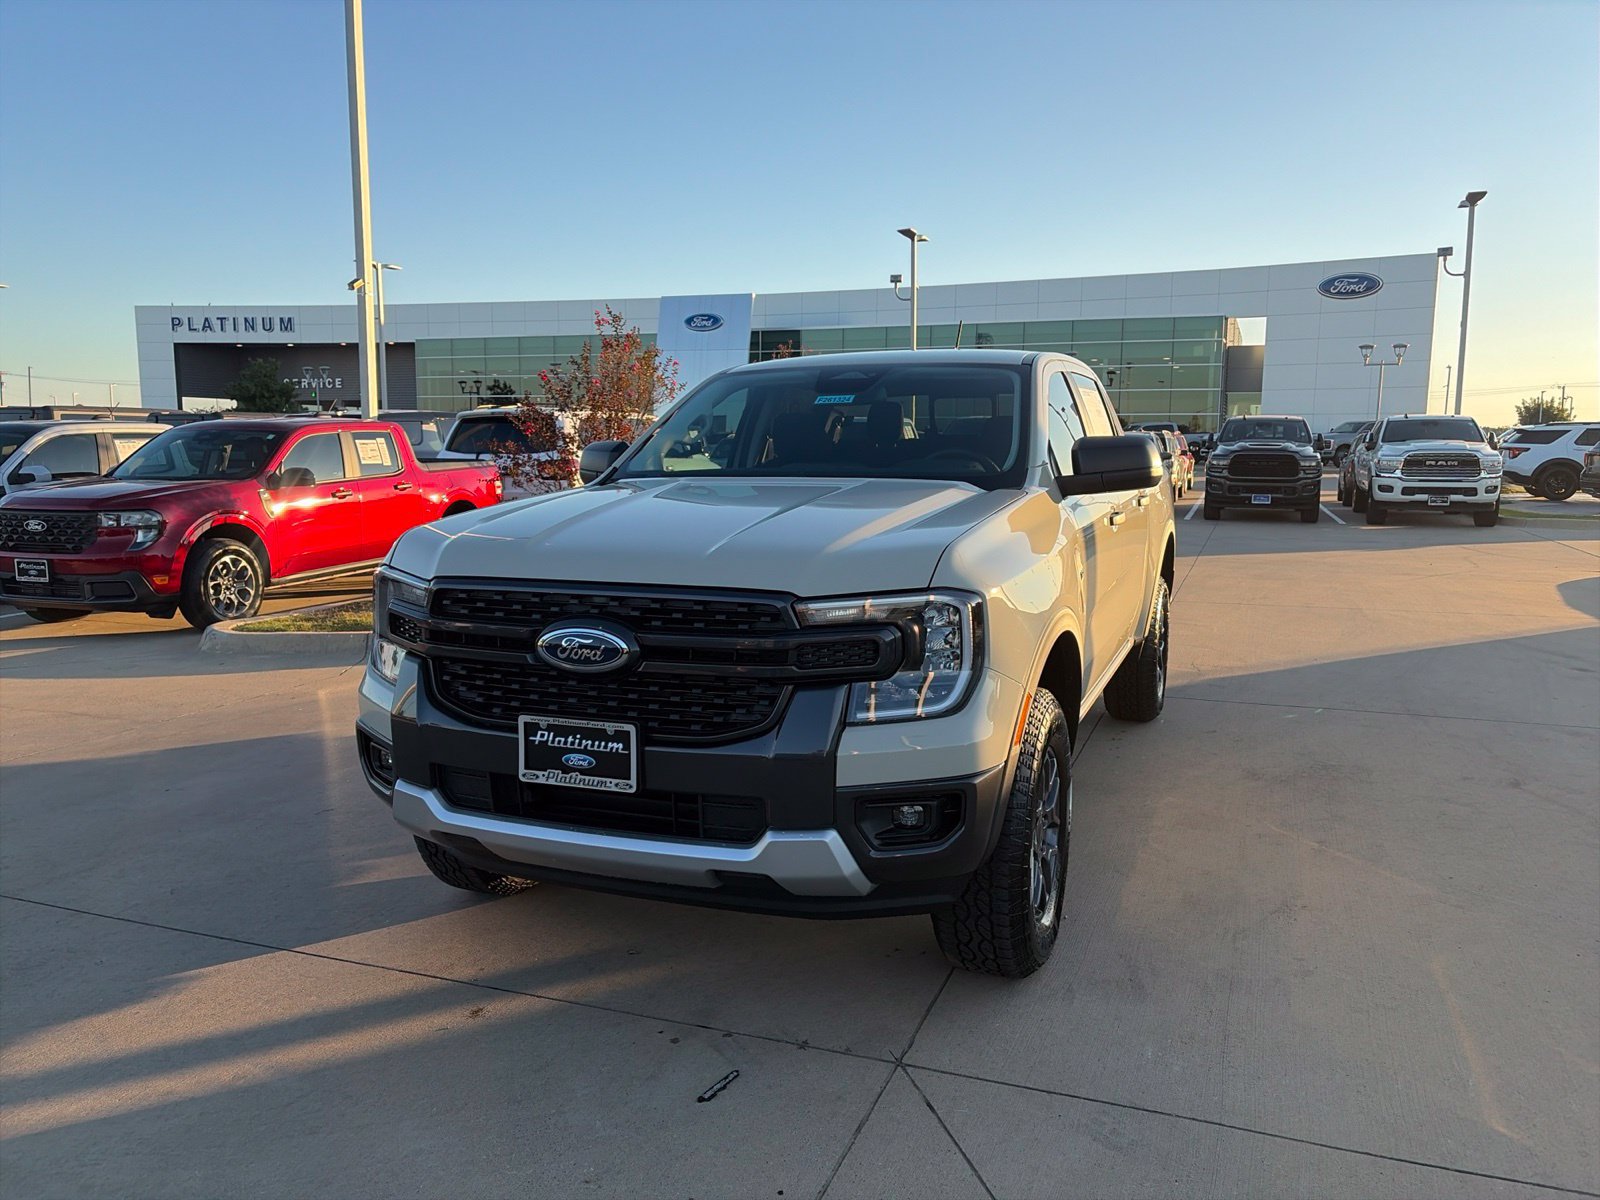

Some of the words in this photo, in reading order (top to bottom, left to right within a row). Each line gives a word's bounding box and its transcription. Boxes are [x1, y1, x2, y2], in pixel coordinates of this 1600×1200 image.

[1330, 277, 1368, 293] Ford
[171, 316, 296, 333] PLATINUM
[690, 316, 714, 327] Ford
[27, 521, 43, 530] Ford
[556, 636, 606, 661] Ford
[529, 717, 625, 730] www.PlatinumFord.com
[528, 730, 630, 754] Platinum
[567, 756, 590, 767] Ford
[545, 770, 612, 789] Platinum
